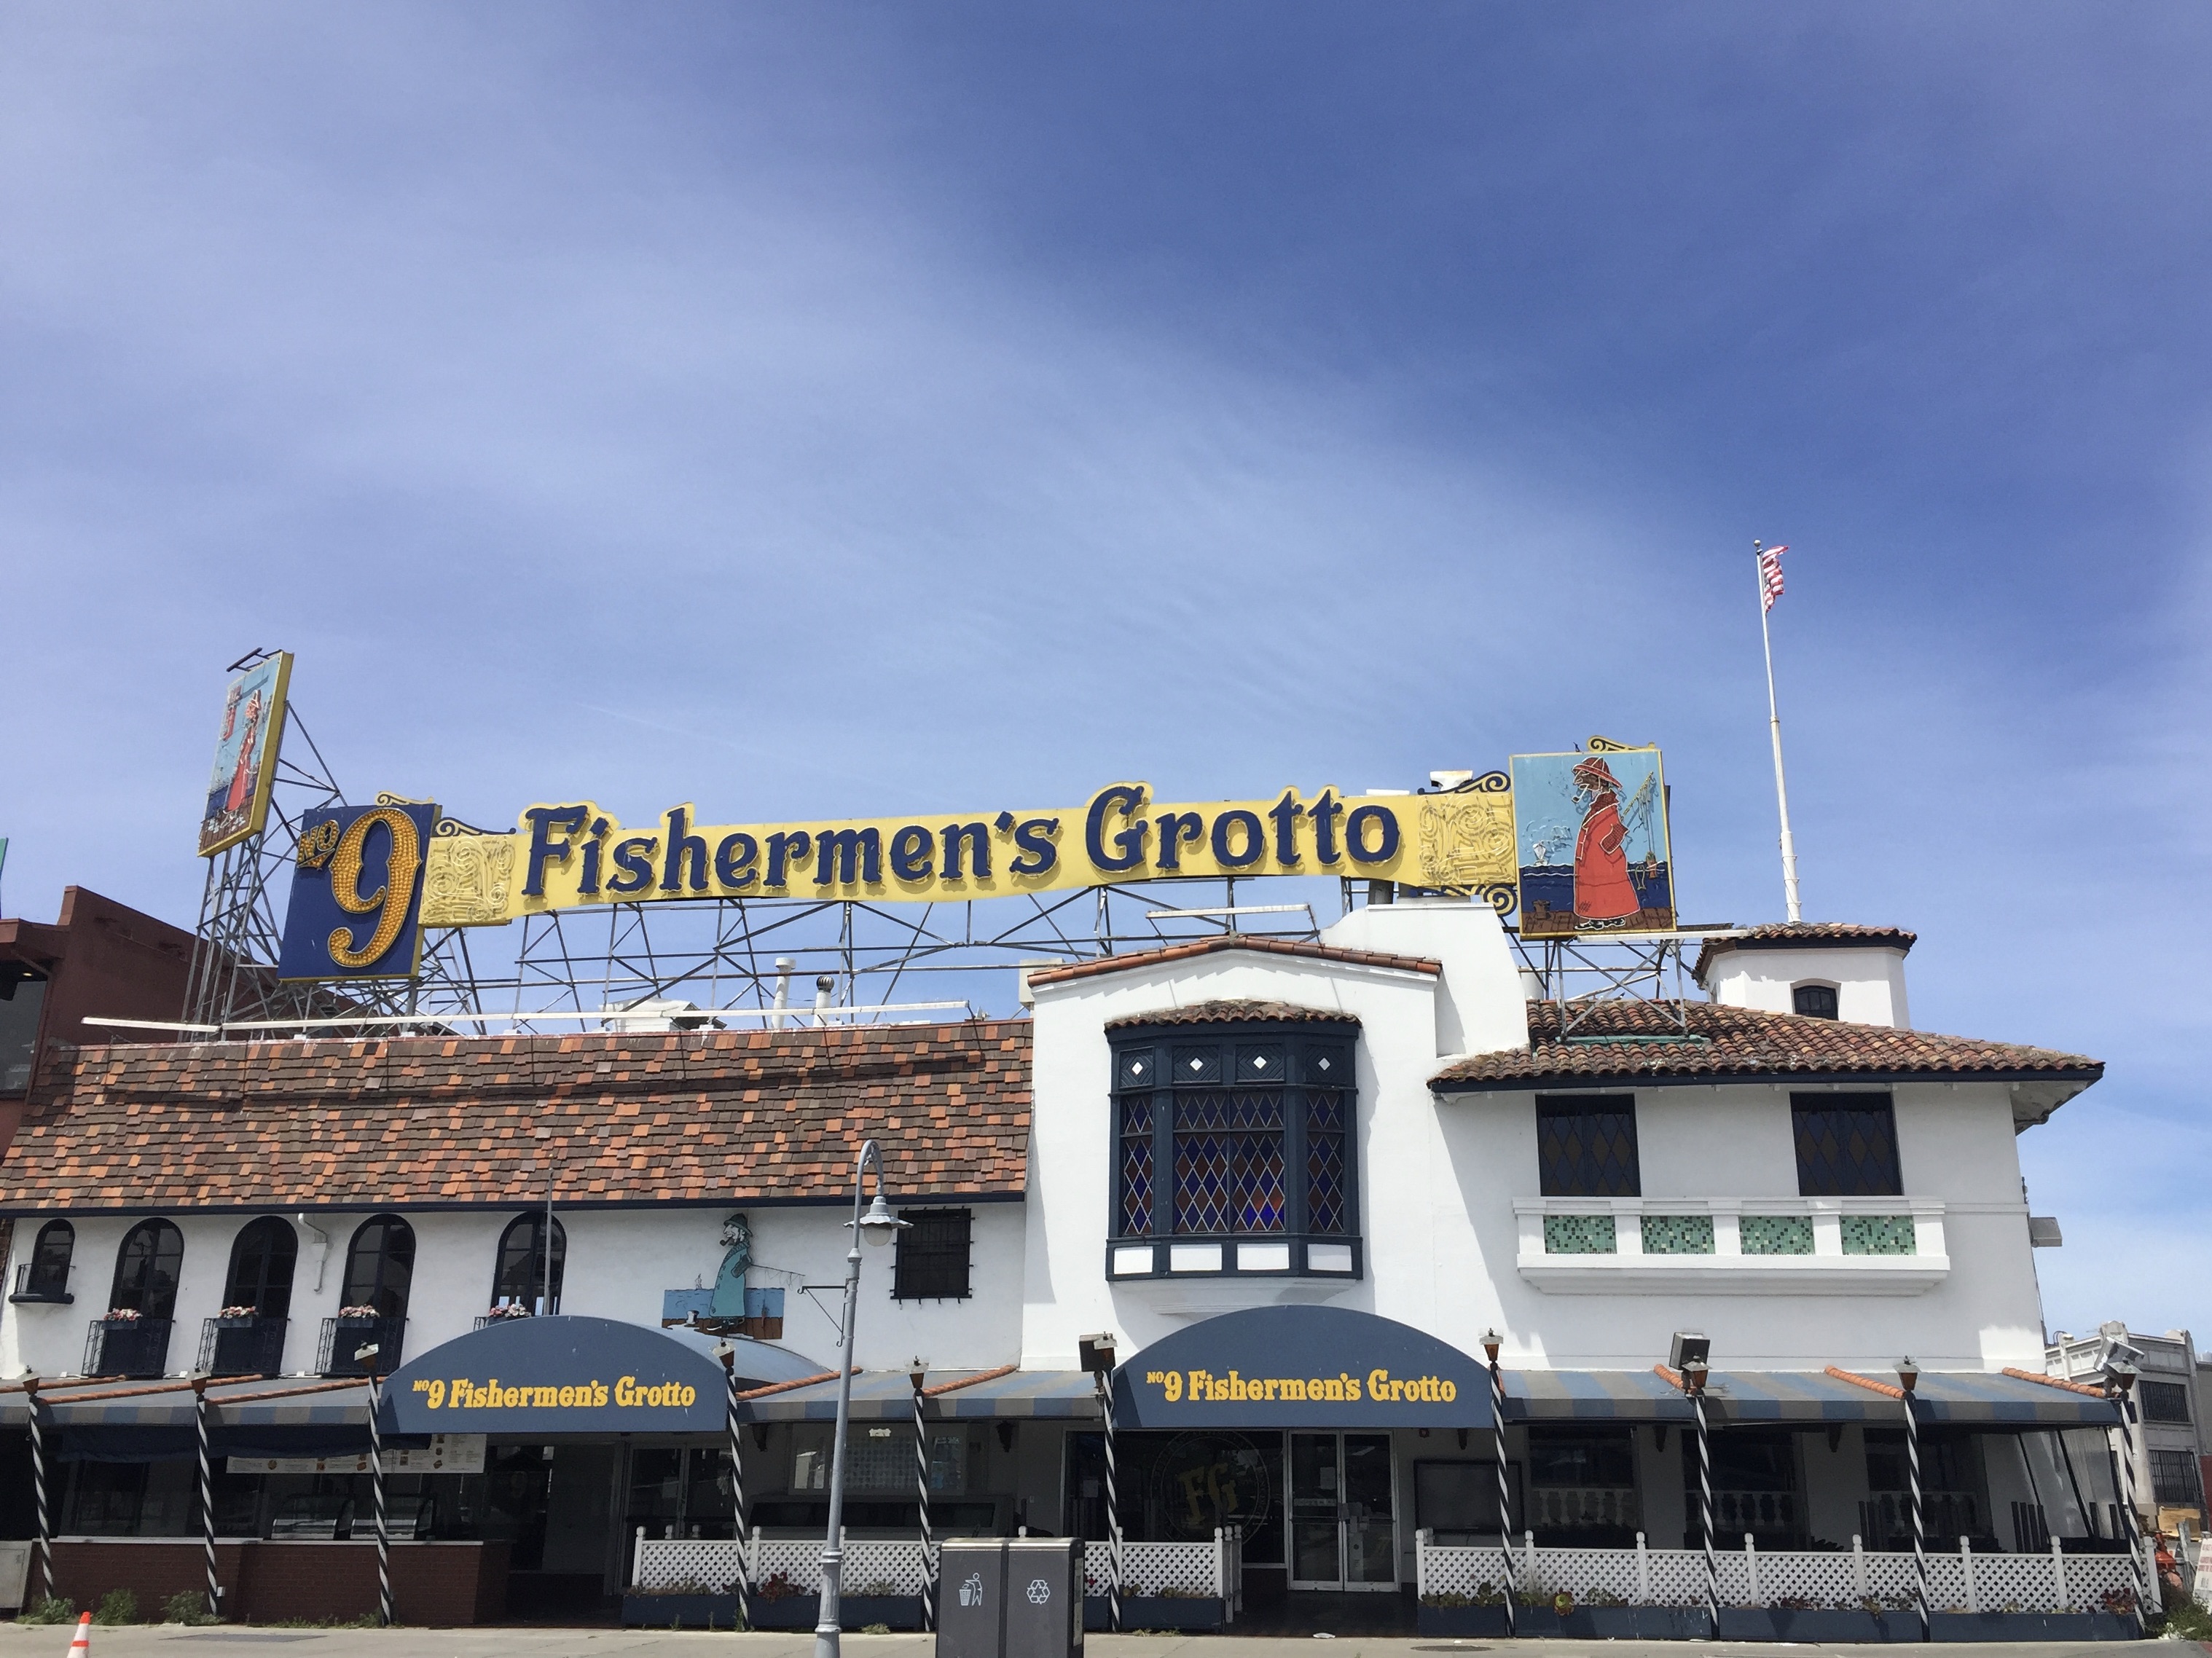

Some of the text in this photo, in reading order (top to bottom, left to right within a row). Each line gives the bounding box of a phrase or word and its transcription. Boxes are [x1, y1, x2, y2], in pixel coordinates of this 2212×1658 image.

[521, 786, 1400, 897] Fishermen's Grotto
[329, 807, 423, 967] 9
[448, 1378, 609, 1408] Fishermen's
[614, 1375, 697, 1407] Grotto
[1188, 1370, 1361, 1402] Fishermen's
[1367, 1369, 1457, 1402] Grotto
